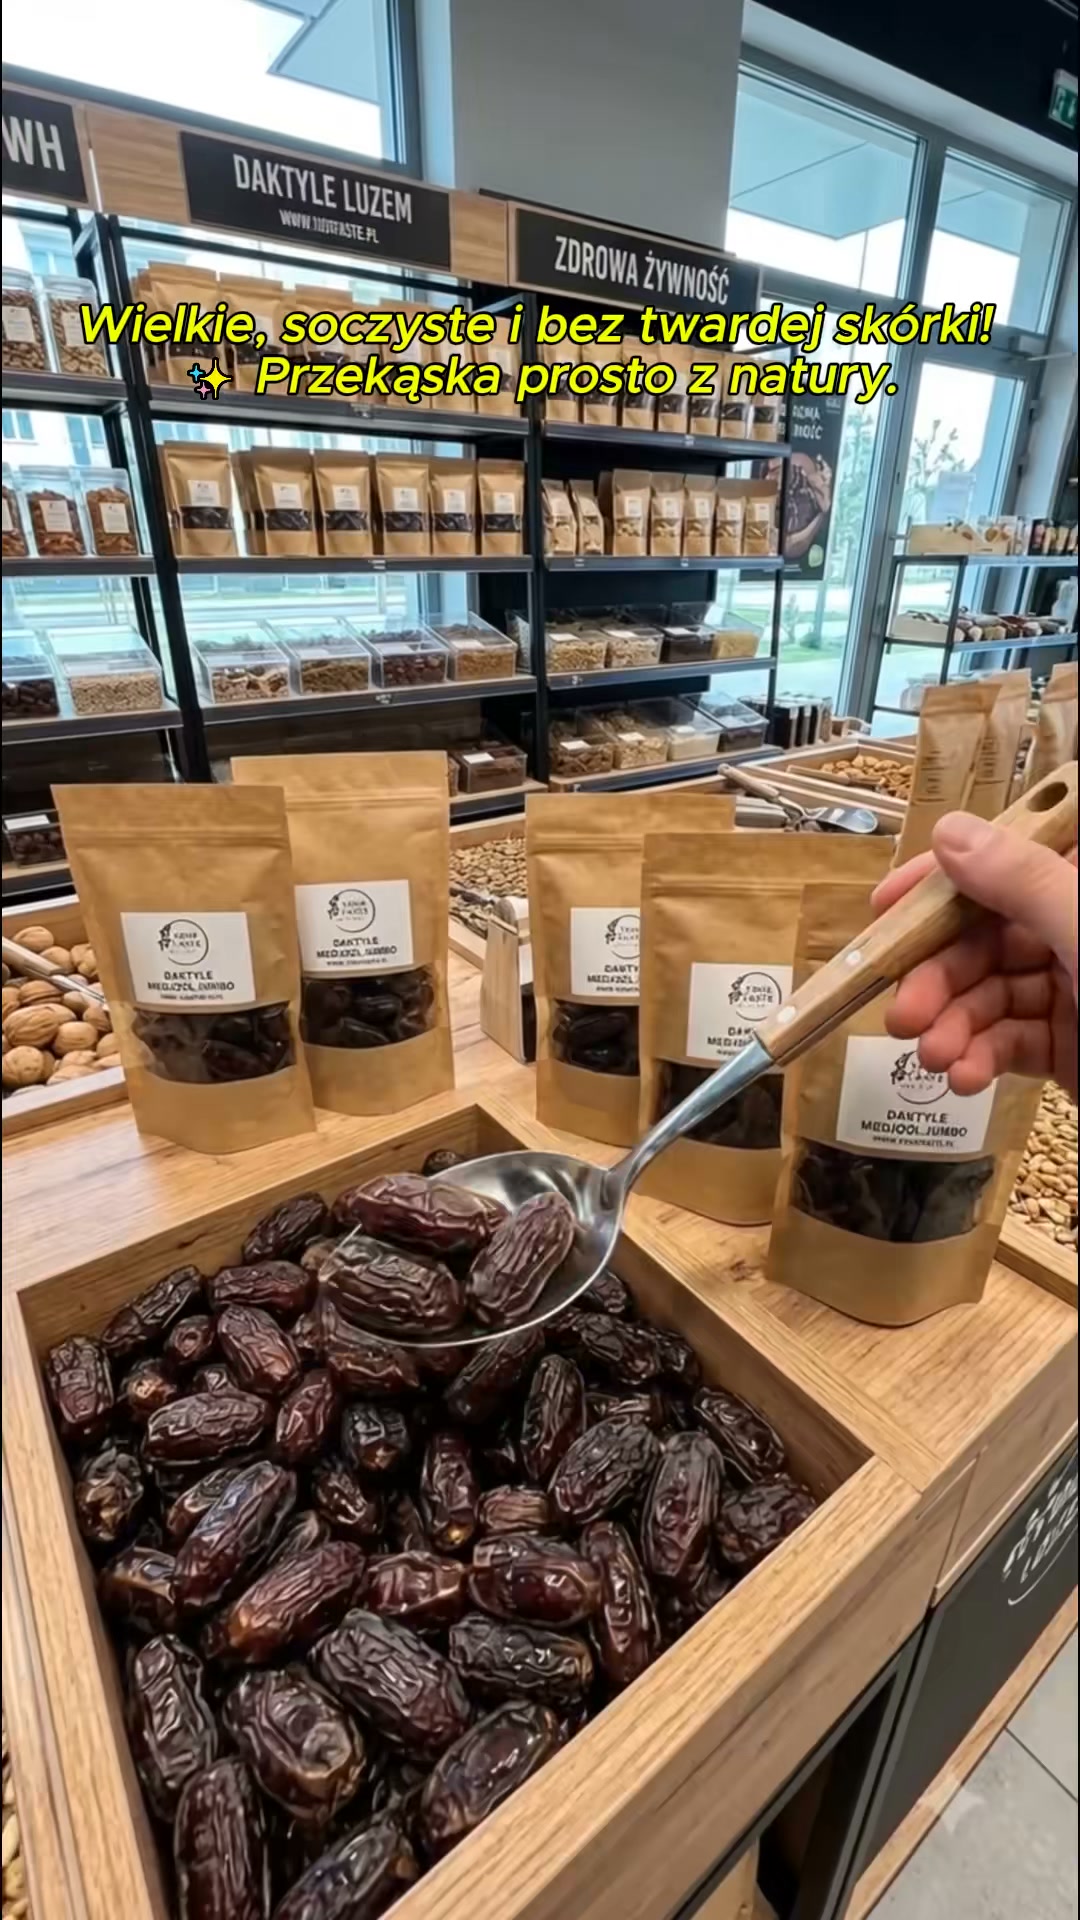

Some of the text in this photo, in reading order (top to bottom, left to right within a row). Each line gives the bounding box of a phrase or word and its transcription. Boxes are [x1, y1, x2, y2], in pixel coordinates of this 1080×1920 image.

[233, 153, 412, 225] DAKTYLE LUZEM
[554, 235, 730, 306] ZDROWA ŻYWNOŚĆ
